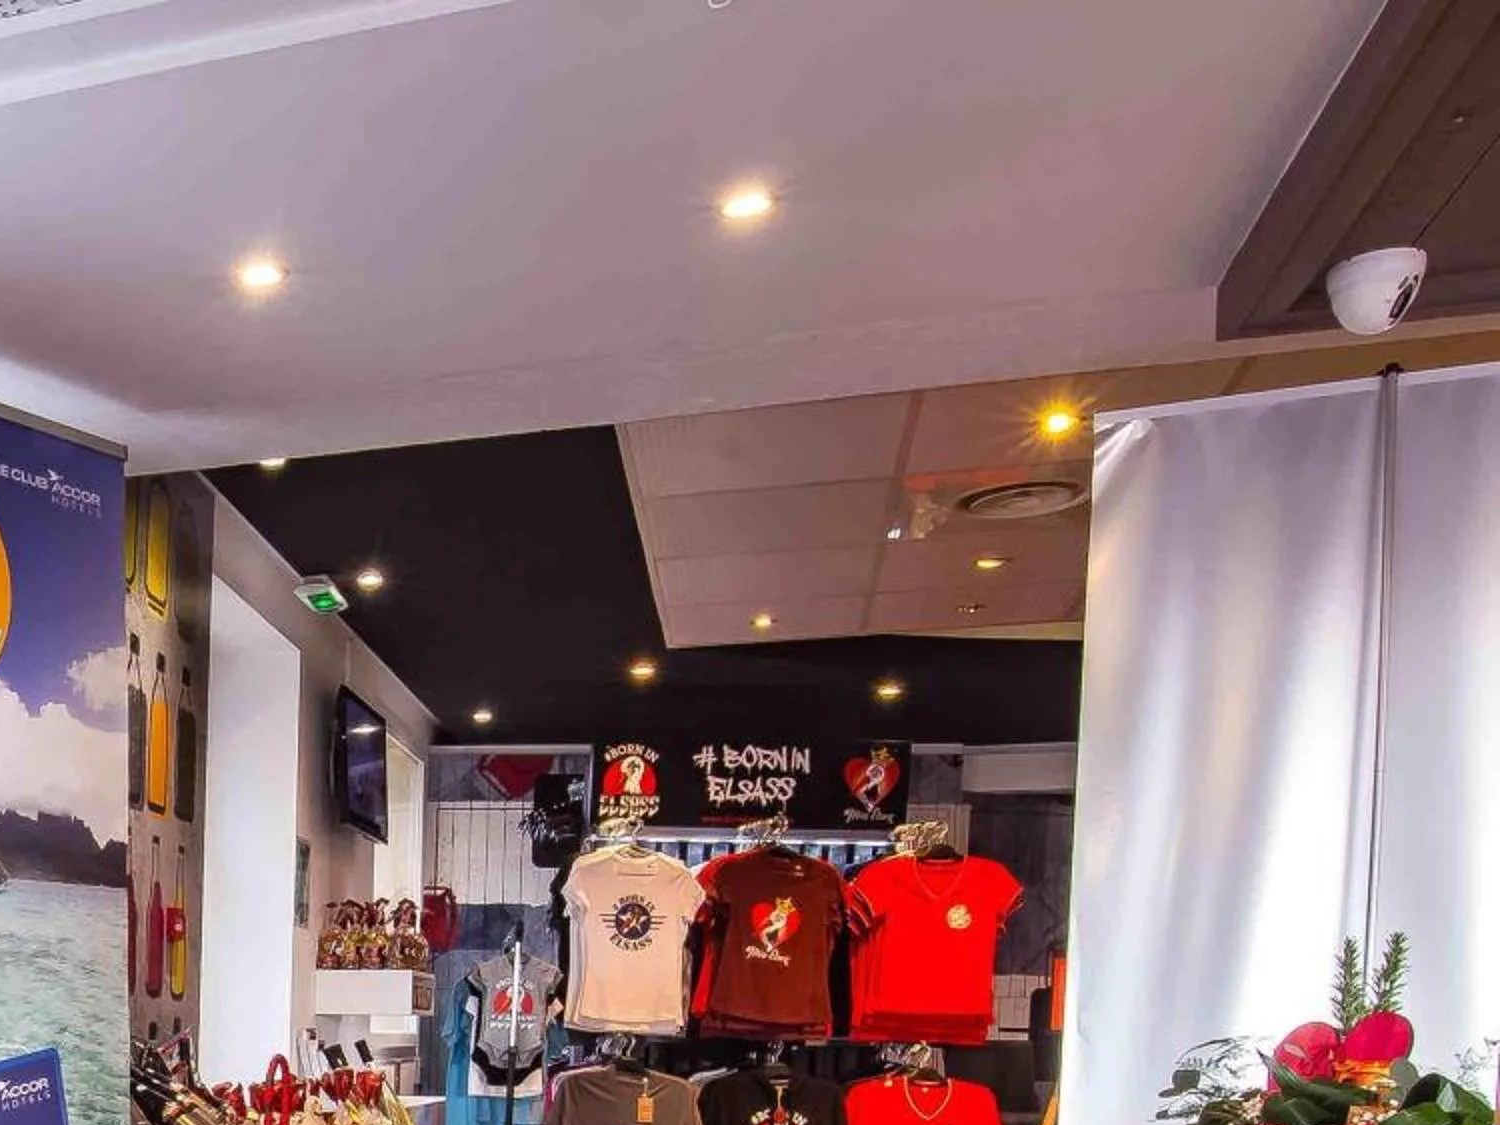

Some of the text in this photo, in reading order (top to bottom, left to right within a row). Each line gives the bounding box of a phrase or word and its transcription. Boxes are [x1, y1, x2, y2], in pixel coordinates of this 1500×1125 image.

[11, 467, 49, 489] CLUB
[51, 481, 101, 506] ACCOR
[723, 744, 788, 774] BORN
[790, 746, 811, 776] IN
[706, 774, 798, 808] ELSASS
[1, 1077, 50, 1101] ACCOR
[2, 1091, 52, 1112] HOTELS
